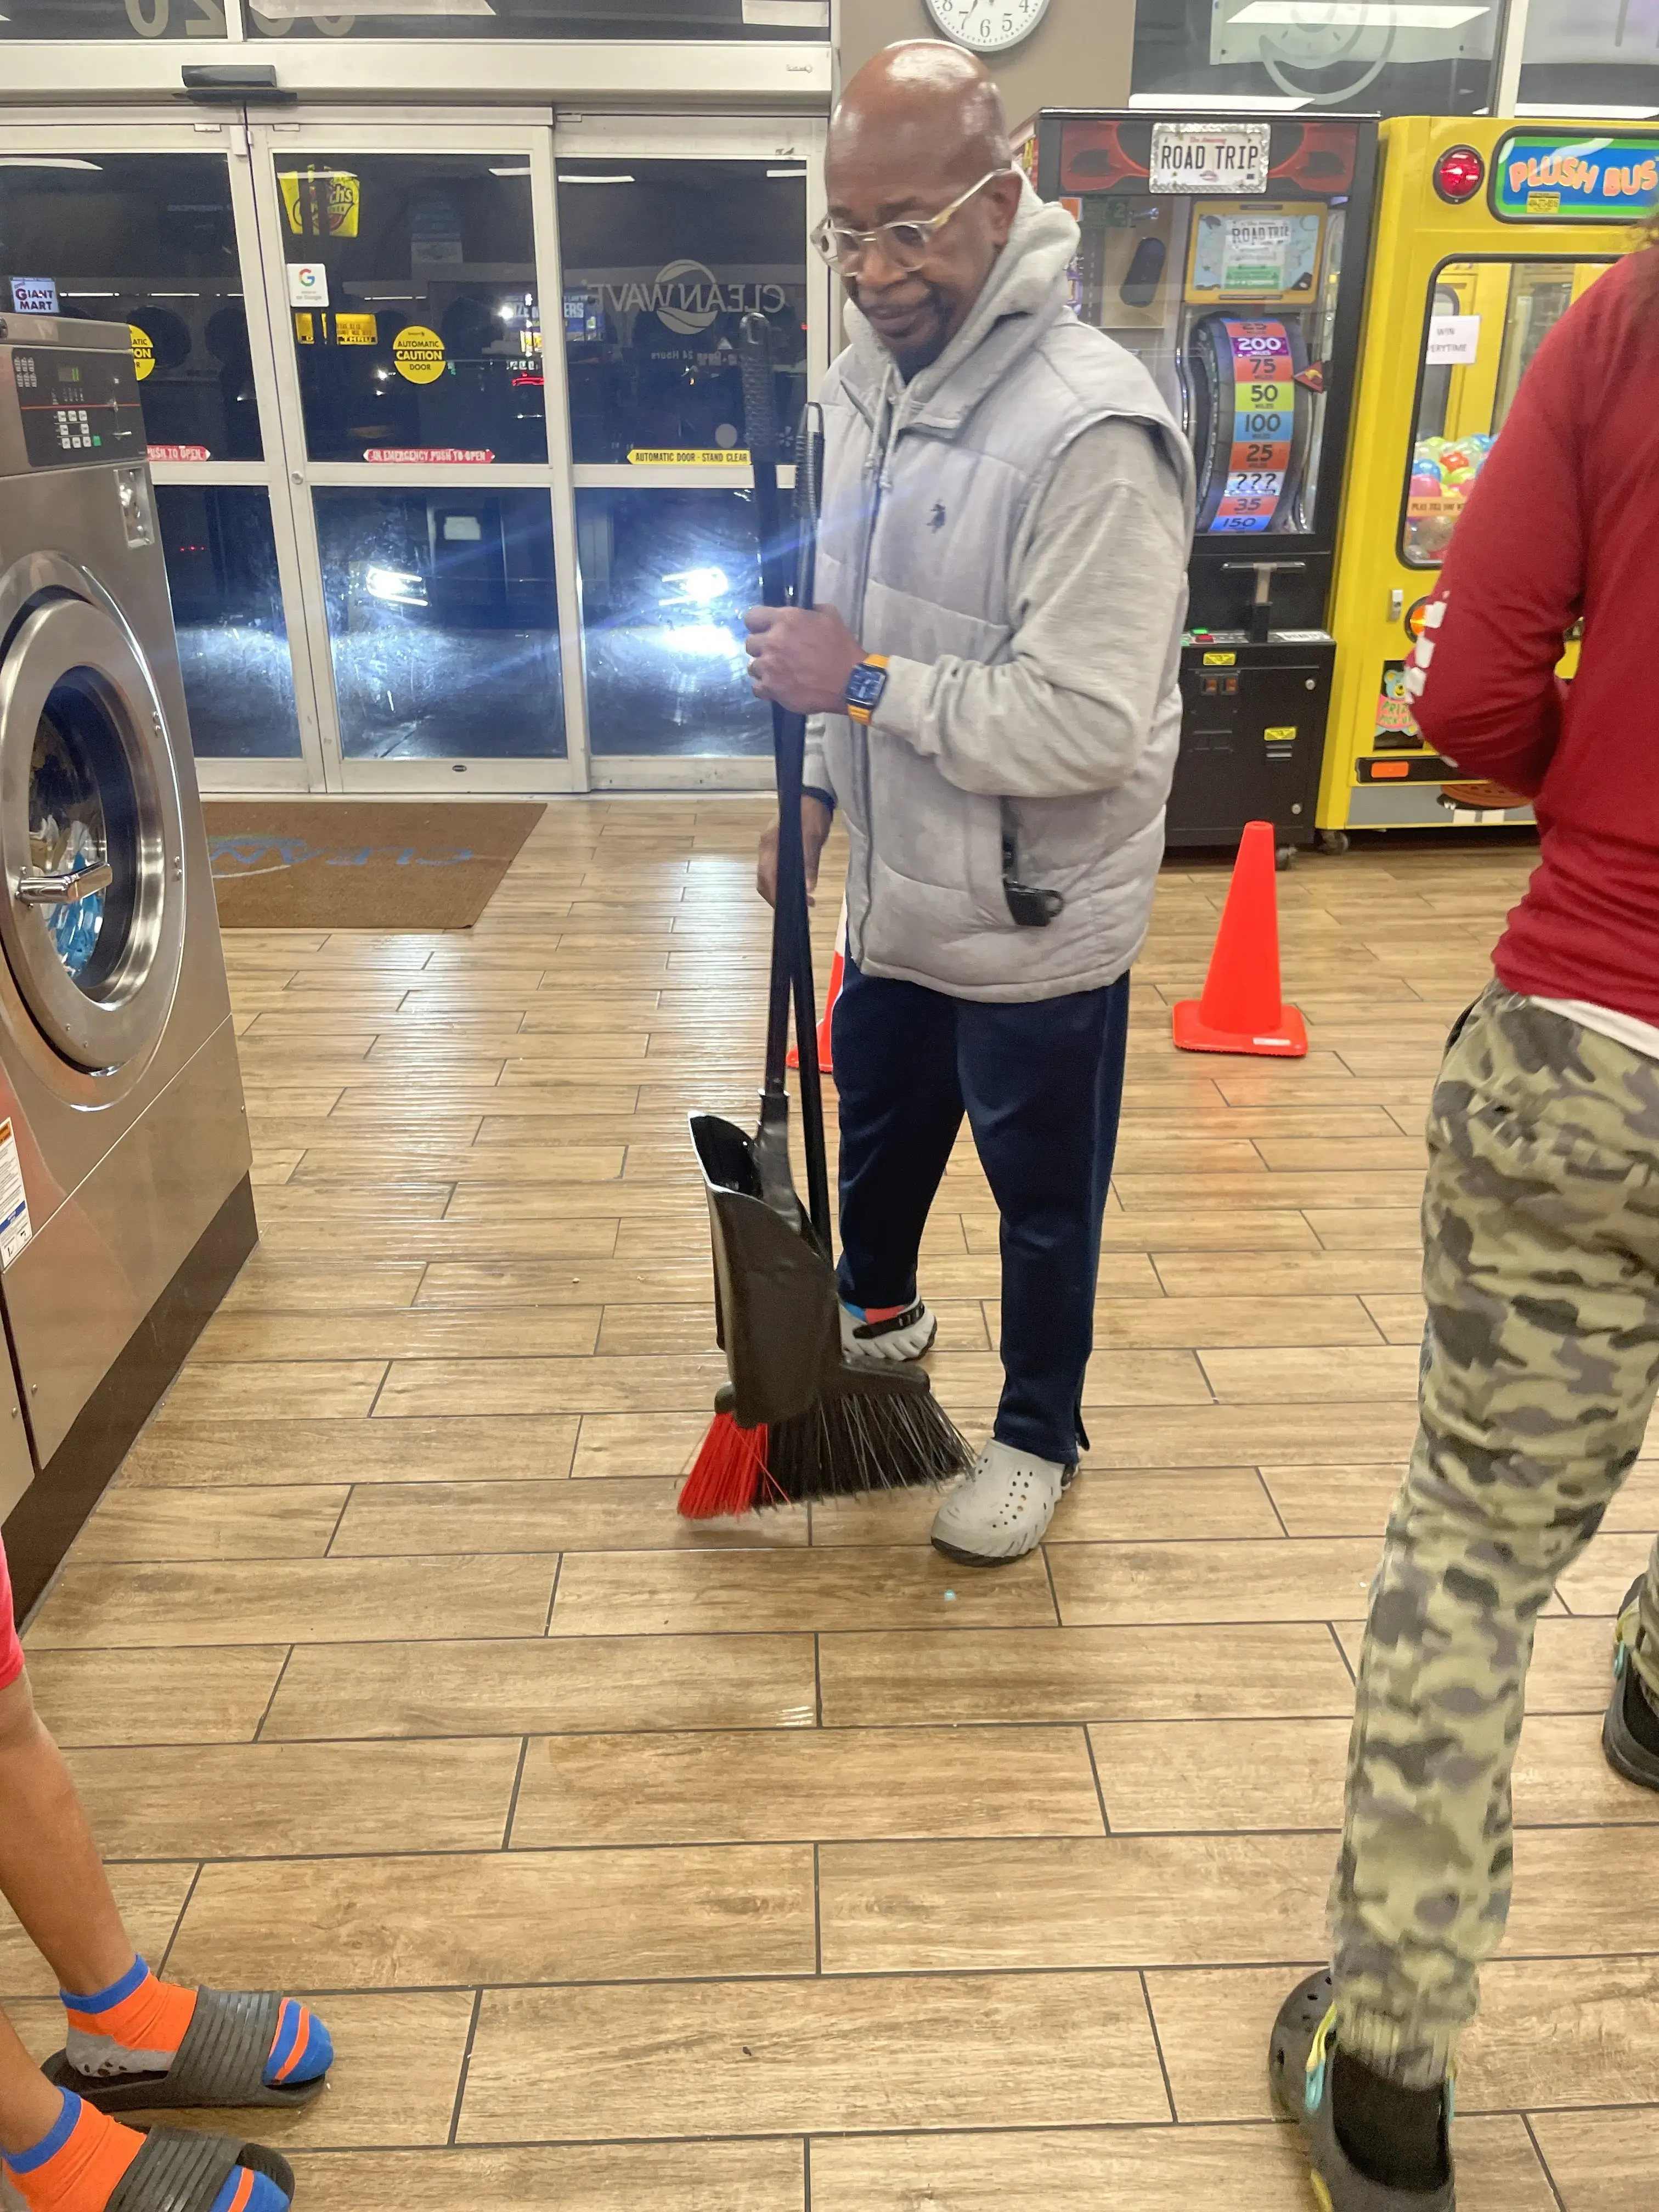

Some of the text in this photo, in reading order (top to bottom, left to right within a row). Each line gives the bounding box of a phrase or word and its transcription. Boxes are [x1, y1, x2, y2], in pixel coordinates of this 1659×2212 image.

[980, 19, 991, 38] 6
[1002, 13, 1013, 32] 5
[1161, 145, 1259, 170] ROAD TRIP
[1509, 156, 1656, 196] PLUSH BUS
[298, 268, 315, 287] G
[15, 288, 53, 301] GIANT
[20, 301, 52, 311] MART
[1237, 337, 1282, 351] 200
[396, 350, 443, 360] CAUTION
[1249, 358, 1276, 374] 75
[1250, 385, 1278, 403] 50
[1245, 414, 1282, 432] 100
[167, 448, 178, 459] TO
[383, 450, 428, 461] EMERGENCY
[453, 450, 463, 461] TO
[465, 451, 486, 461] OPEN
[635, 453, 674, 461] AUTOMATIC
[676, 453, 696, 461] DOOR
[702, 453, 724, 462] STAND
[726, 453, 747, 461] CLEAR
[1246, 444, 1273, 462] 25
[1234, 498, 1261, 511] 35
[1223, 517, 1256, 528] 150
[1381, 700, 1409, 715] PRIZ
